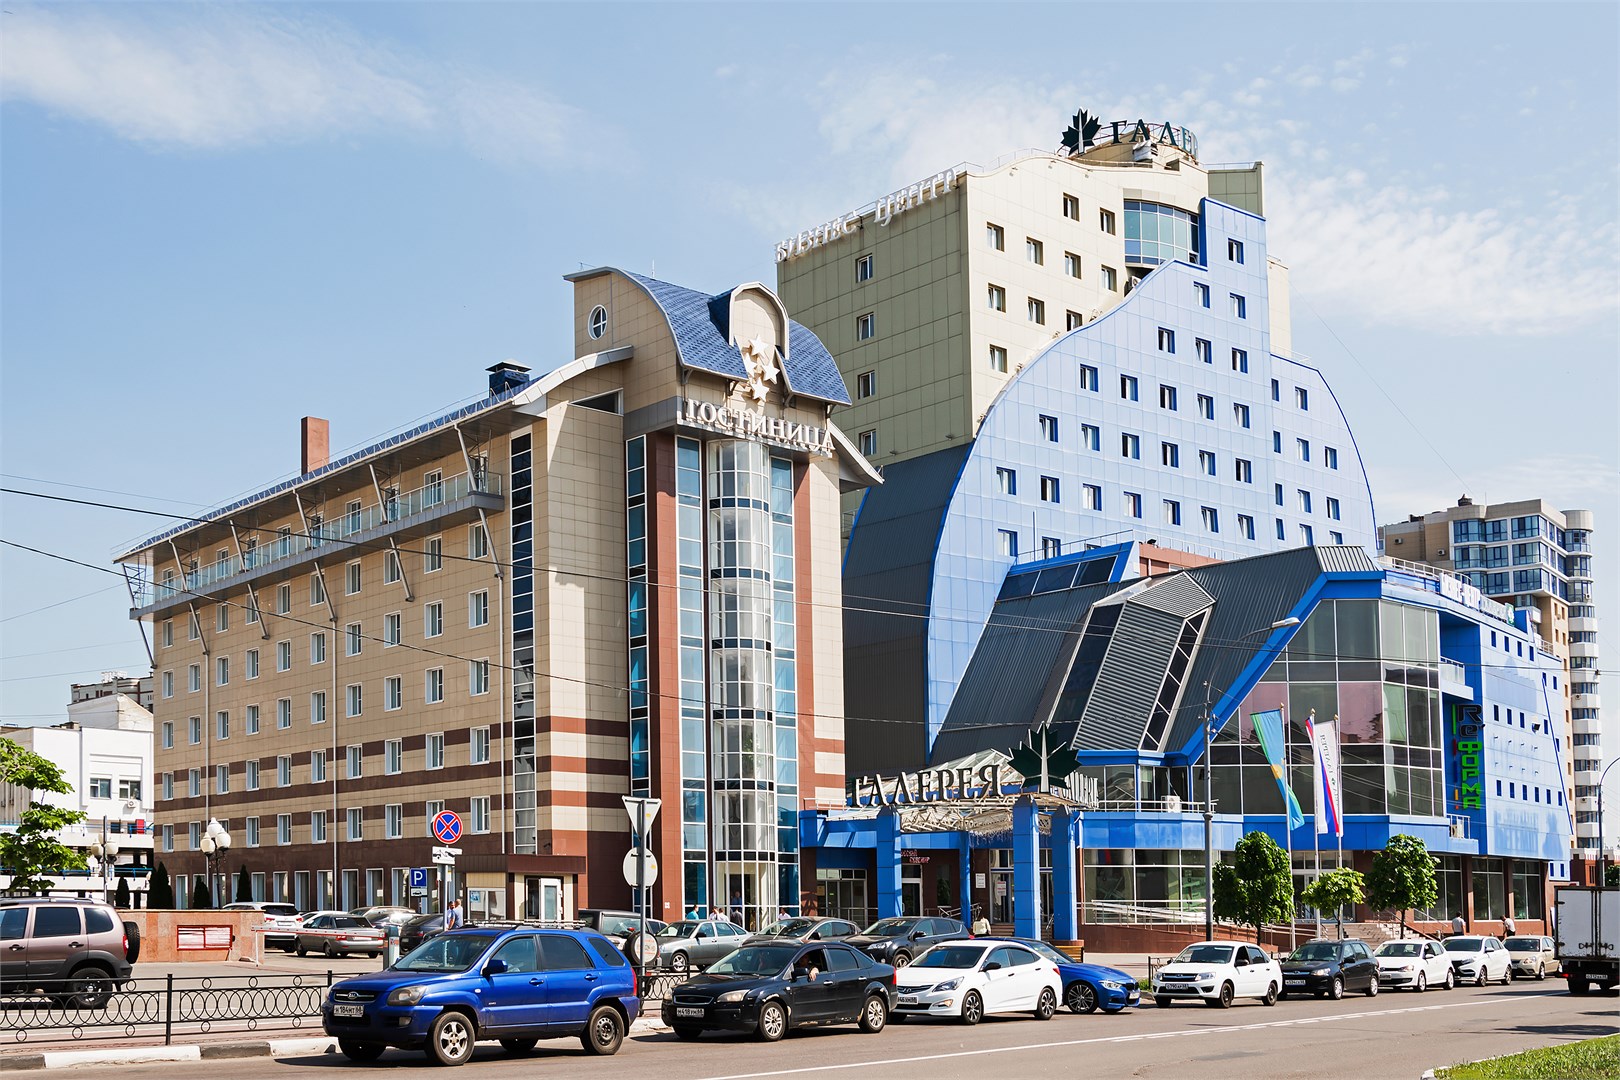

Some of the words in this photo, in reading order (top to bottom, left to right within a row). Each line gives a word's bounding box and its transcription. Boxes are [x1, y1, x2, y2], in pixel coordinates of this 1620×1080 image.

[775, 210, 858, 264] БИЗНЕС
[874, 168, 957, 227] ЦЕНТР
[686, 398, 835, 452] ГОСТИНИЦА
[851, 764, 1003, 807] ГАЛЕРЕЯ
[414, 871, 423, 885] P
